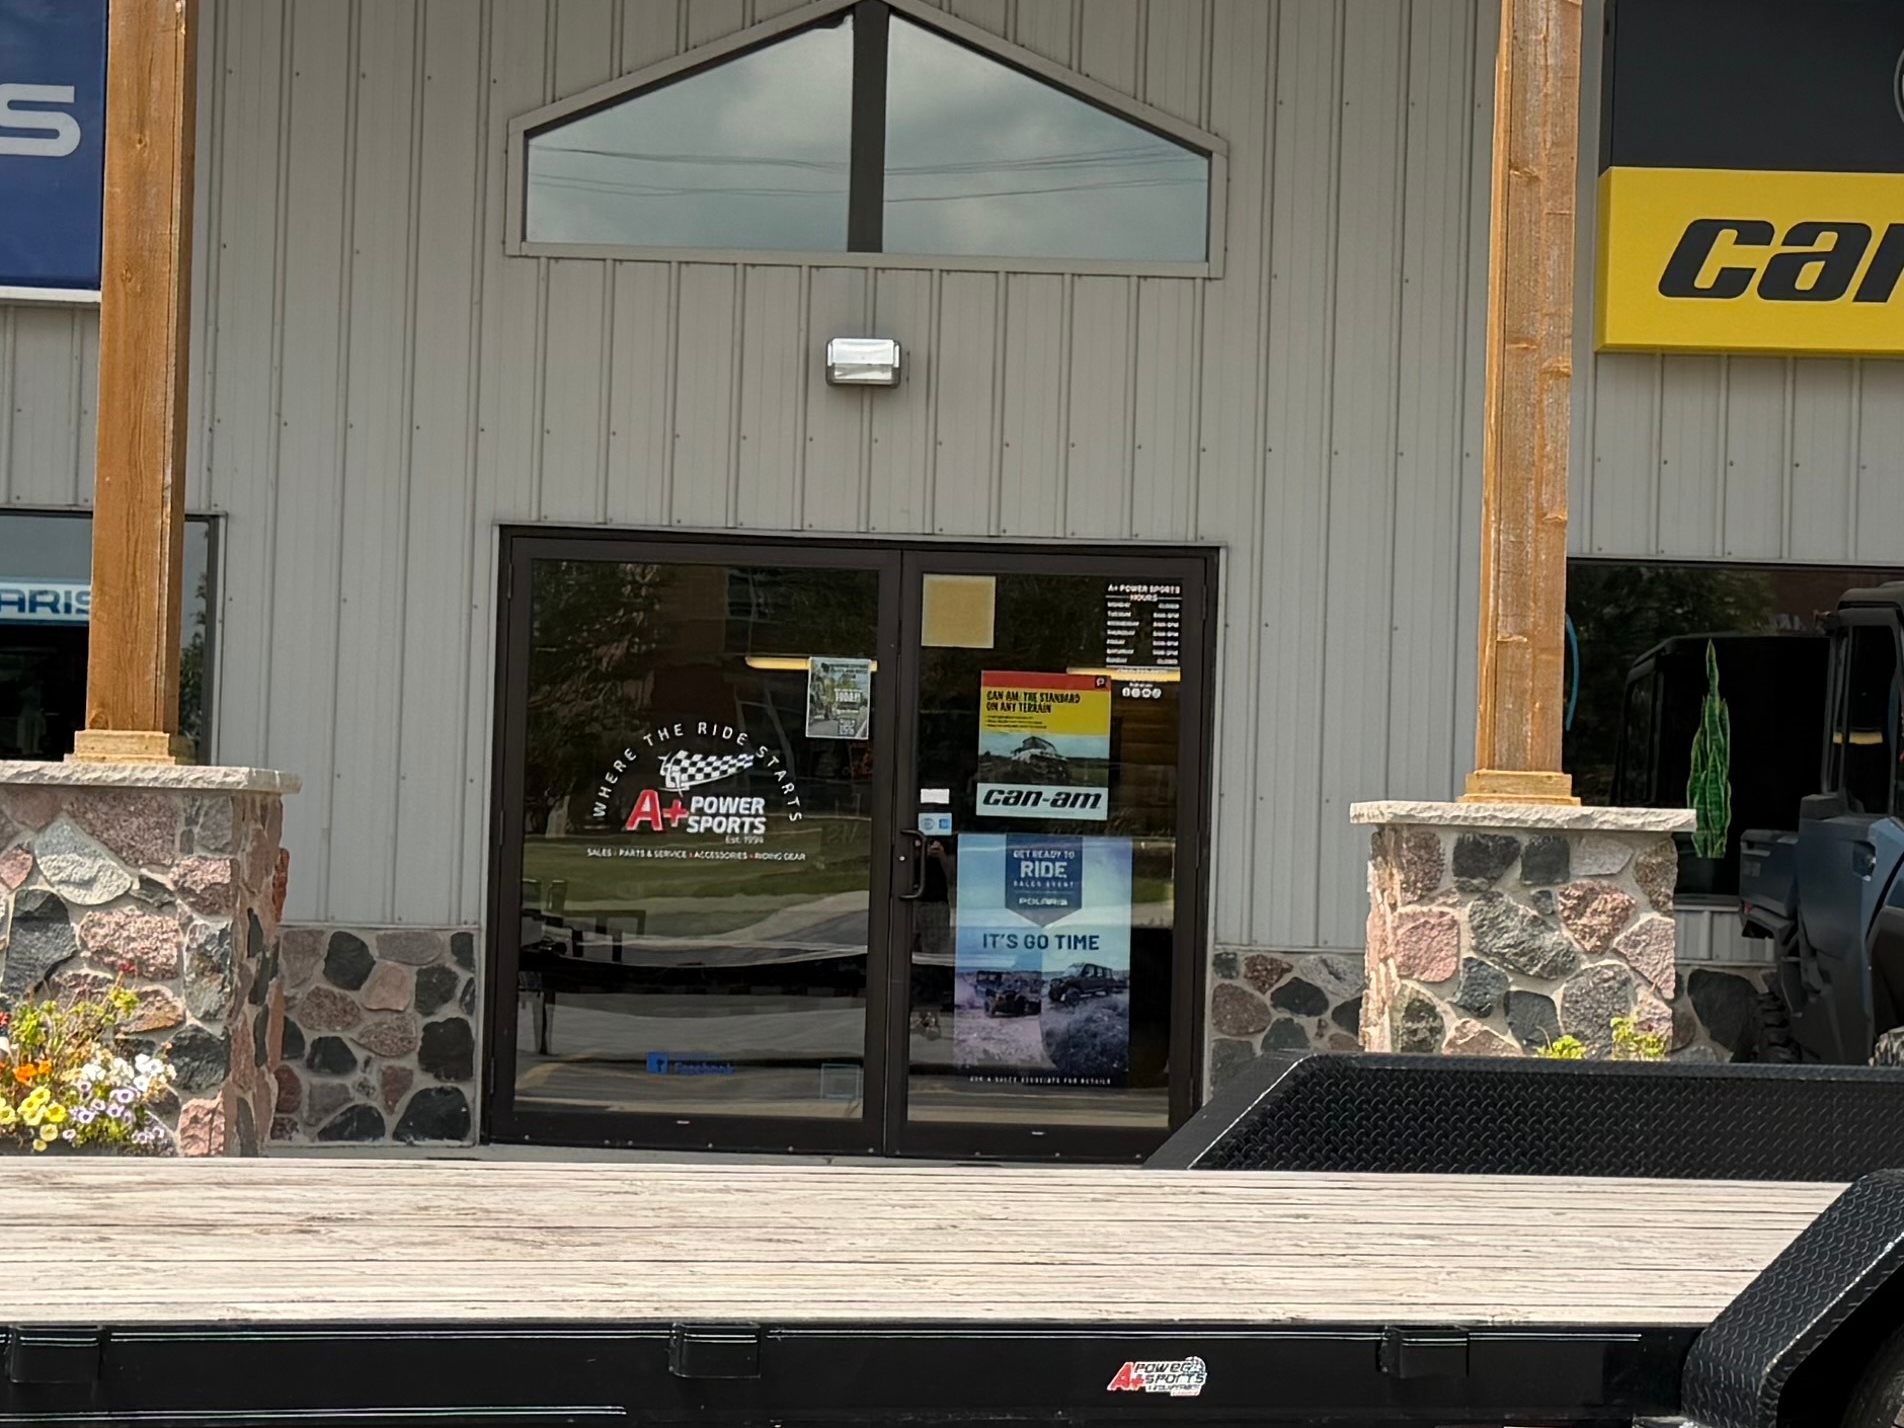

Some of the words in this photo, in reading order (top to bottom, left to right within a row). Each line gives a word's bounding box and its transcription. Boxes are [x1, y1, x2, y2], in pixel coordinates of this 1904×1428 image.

[592, 747, 638, 819] WHERE
[643, 723, 684, 747] THE
[698, 721, 748, 746] RIDE
[755, 745, 803, 822] STARTS
[625, 788, 690, 832] A+
[690, 795, 766, 815] POWER
[686, 816, 767, 835] SPORTS
[1020, 860, 1068, 879] RIDE
[982, 933, 1019, 950] IT'S
[1023, 934, 1050, 950] GO
[1054, 934, 1100, 951] TIME
